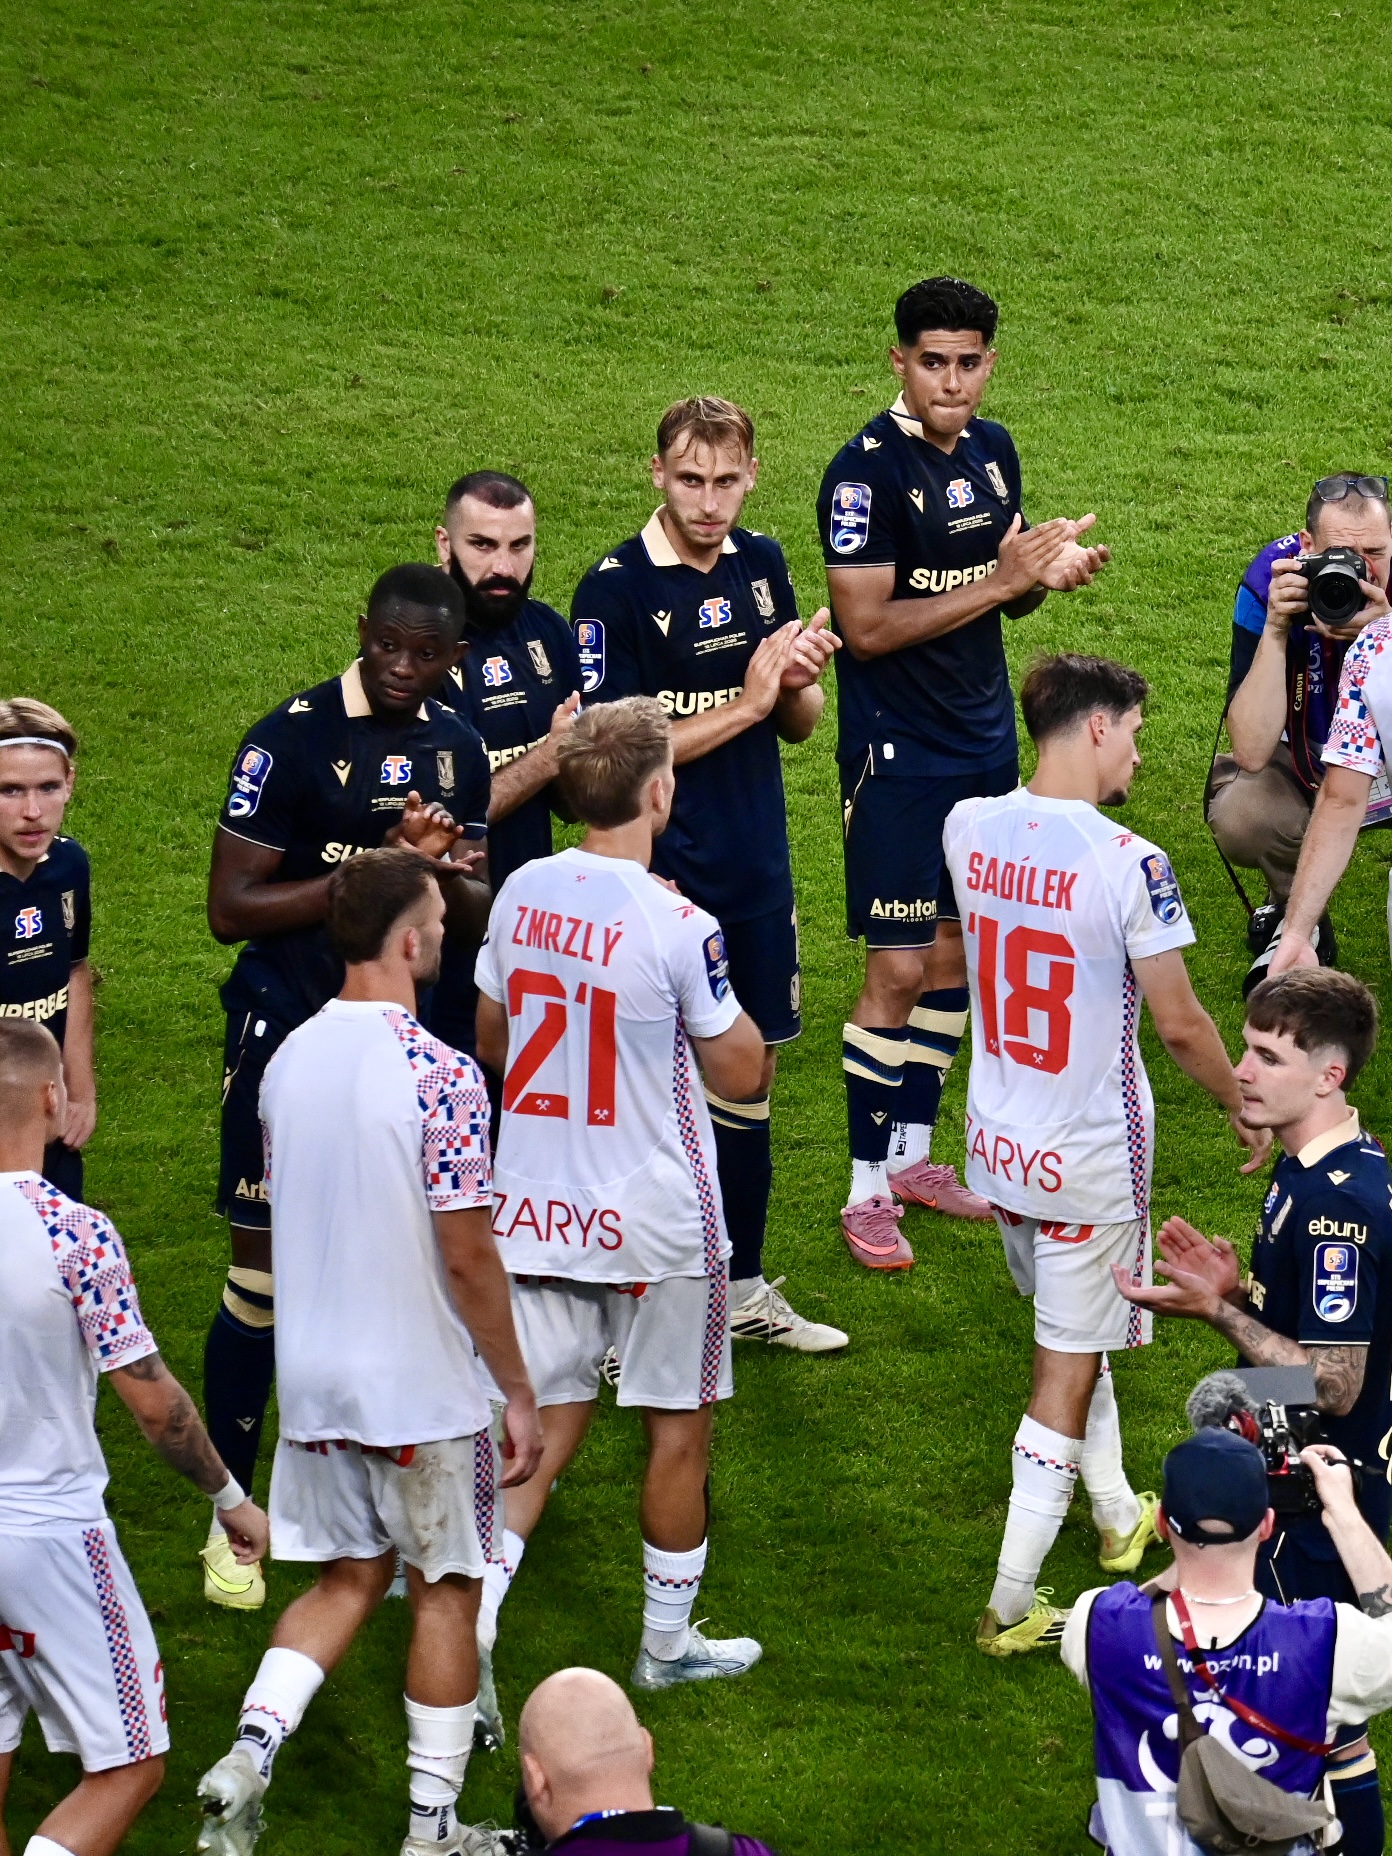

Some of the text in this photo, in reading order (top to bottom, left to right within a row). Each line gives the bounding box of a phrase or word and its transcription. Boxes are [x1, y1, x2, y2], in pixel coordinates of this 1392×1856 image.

[946, 478, 975, 509] STS
[699, 597, 732, 628] STS
[482, 656, 512, 686] STS
[1293, 672, 1304, 712] Canon
[380, 755, 422, 785] STS
[966, 851, 1079, 912] SADÍLEK
[14, 906, 43, 939] STS
[512, 905, 624, 967] ZMRZLÝ
[967, 912, 1074, 1075] 18
[503, 967, 617, 1127] 21
[492, 1192, 624, 1251] ZARYS
[1308, 1215, 1367, 1244] ebury
